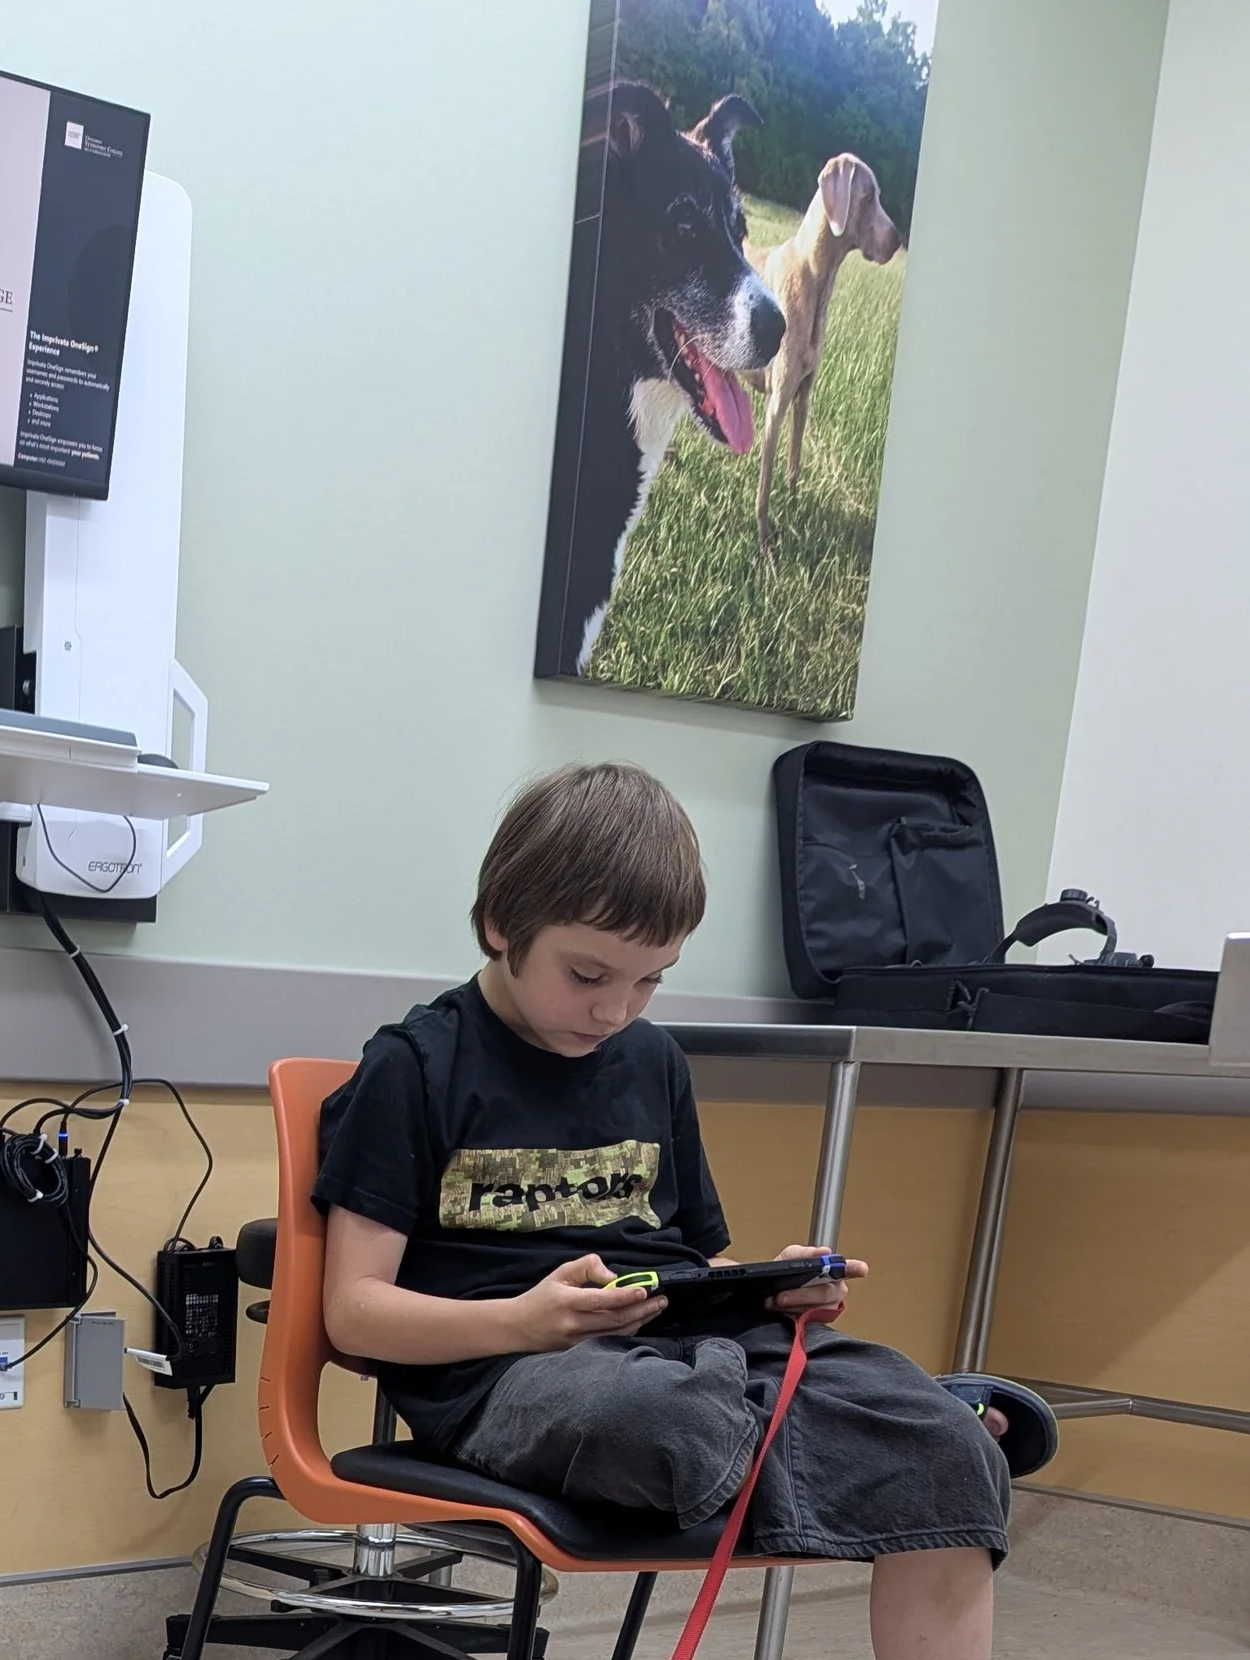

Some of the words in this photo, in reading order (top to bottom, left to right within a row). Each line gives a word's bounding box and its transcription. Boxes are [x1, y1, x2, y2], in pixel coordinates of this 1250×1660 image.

[30, 330, 41, 340] The
[41, 332, 70, 347] Imprivata
[29, 341, 61, 357] Experience
[33, 392, 59, 404] Applications
[88, 860, 141, 875] ERGOTRON
[468, 1171, 643, 1213] raptors
